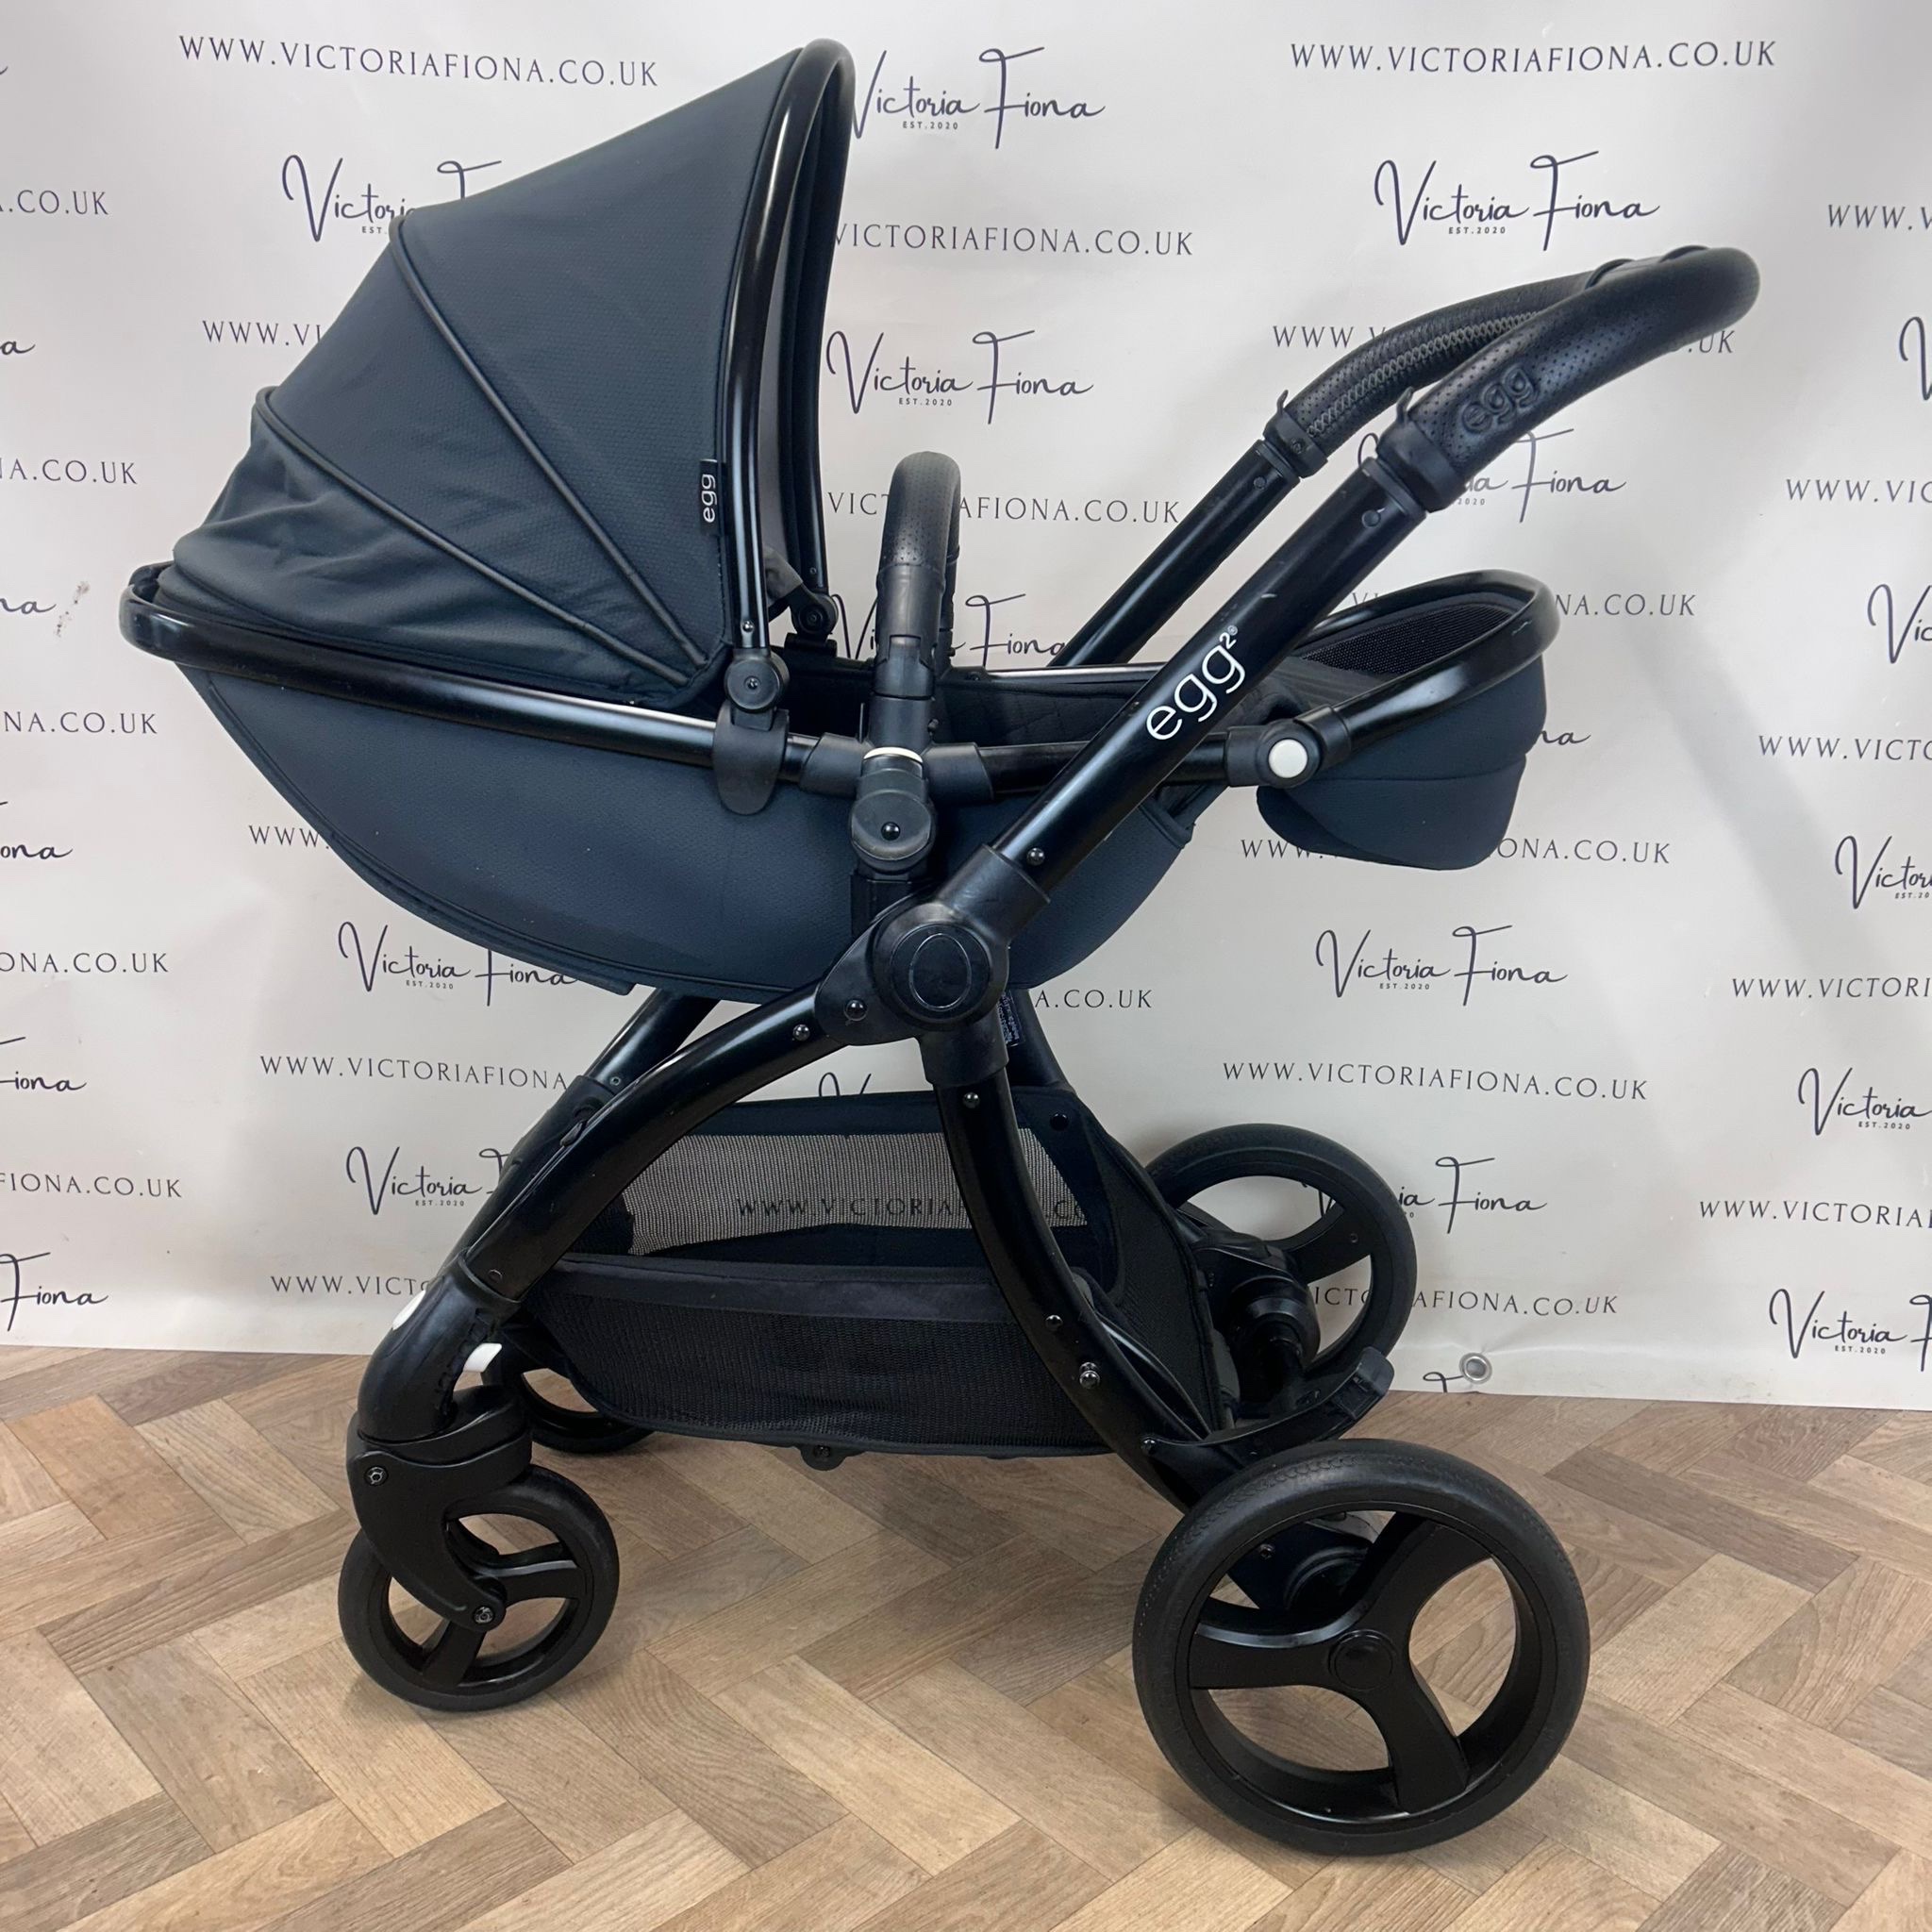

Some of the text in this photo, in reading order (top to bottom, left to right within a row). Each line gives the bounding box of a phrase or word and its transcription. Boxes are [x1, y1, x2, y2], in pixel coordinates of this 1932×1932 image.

[179, 35, 658, 86] WWW.VICTORIAFIONA.CO.UK
[1291, 41, 1775, 73] WWW.VICTORIAFIONA.CO.UK
[853, 46, 1106, 149] Victoria Fiona
[902, 120, 958, 131] EST.2020
[281, 155, 414, 242] Victori
[1374, 151, 1660, 251] Victoria Fiona
[1448, 225, 1507, 235] EST.2020
[826, 330, 1093, 425] Victoria Fiona
[898, 397, 953, 407] EST.2020
[701, 474, 718, 523] egg
[1511, 427, 1627, 524] Fiona
[338, 922, 472, 992] Victoria
[1316, 925, 1568, 1007] Victoria Fiona
[406, 979, 454, 990] EST.2020
[1379, 982, 1430, 991] EST.2020
[1224, 1063, 1647, 1100] WWW.VICTORIAFIONA.CO.UK
[1798, 1067, 1932, 1136] Victoria
[1857, 1120, 1911, 1130] EST.2020
[346, 1146, 483, 1215] Victoria
[414, 1199, 465, 1208] EST.2020
[1435, 1157, 1547, 1234] Fiona
[1700, 1201, 1932, 1228] WWW.VICTORIA
[0, 1252, 108, 1332] Fiona
[1769, 1289, 1907, 1358] Victoria
[1834, 1344, 1887, 1356] EST.2020
